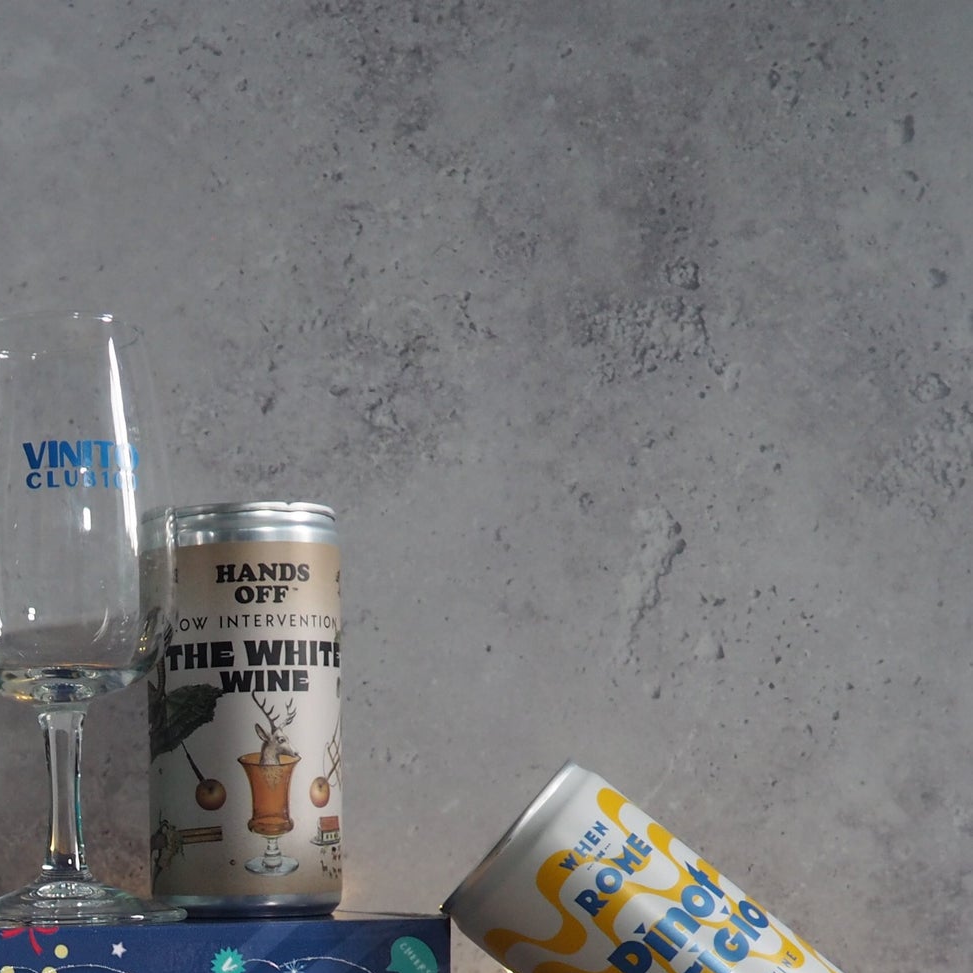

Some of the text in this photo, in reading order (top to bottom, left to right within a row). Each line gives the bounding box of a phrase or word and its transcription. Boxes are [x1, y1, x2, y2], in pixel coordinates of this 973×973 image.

[22, 440, 140, 470] VINITO
[215, 562, 310, 583] HANDS
[175, 614, 337, 632] OW INTERVENTION
[166, 640, 340, 671] THE WHITE
[220, 670, 309, 693] WINE
[559, 821, 609, 870] WHEN
[574, 833, 653, 917] ROME
